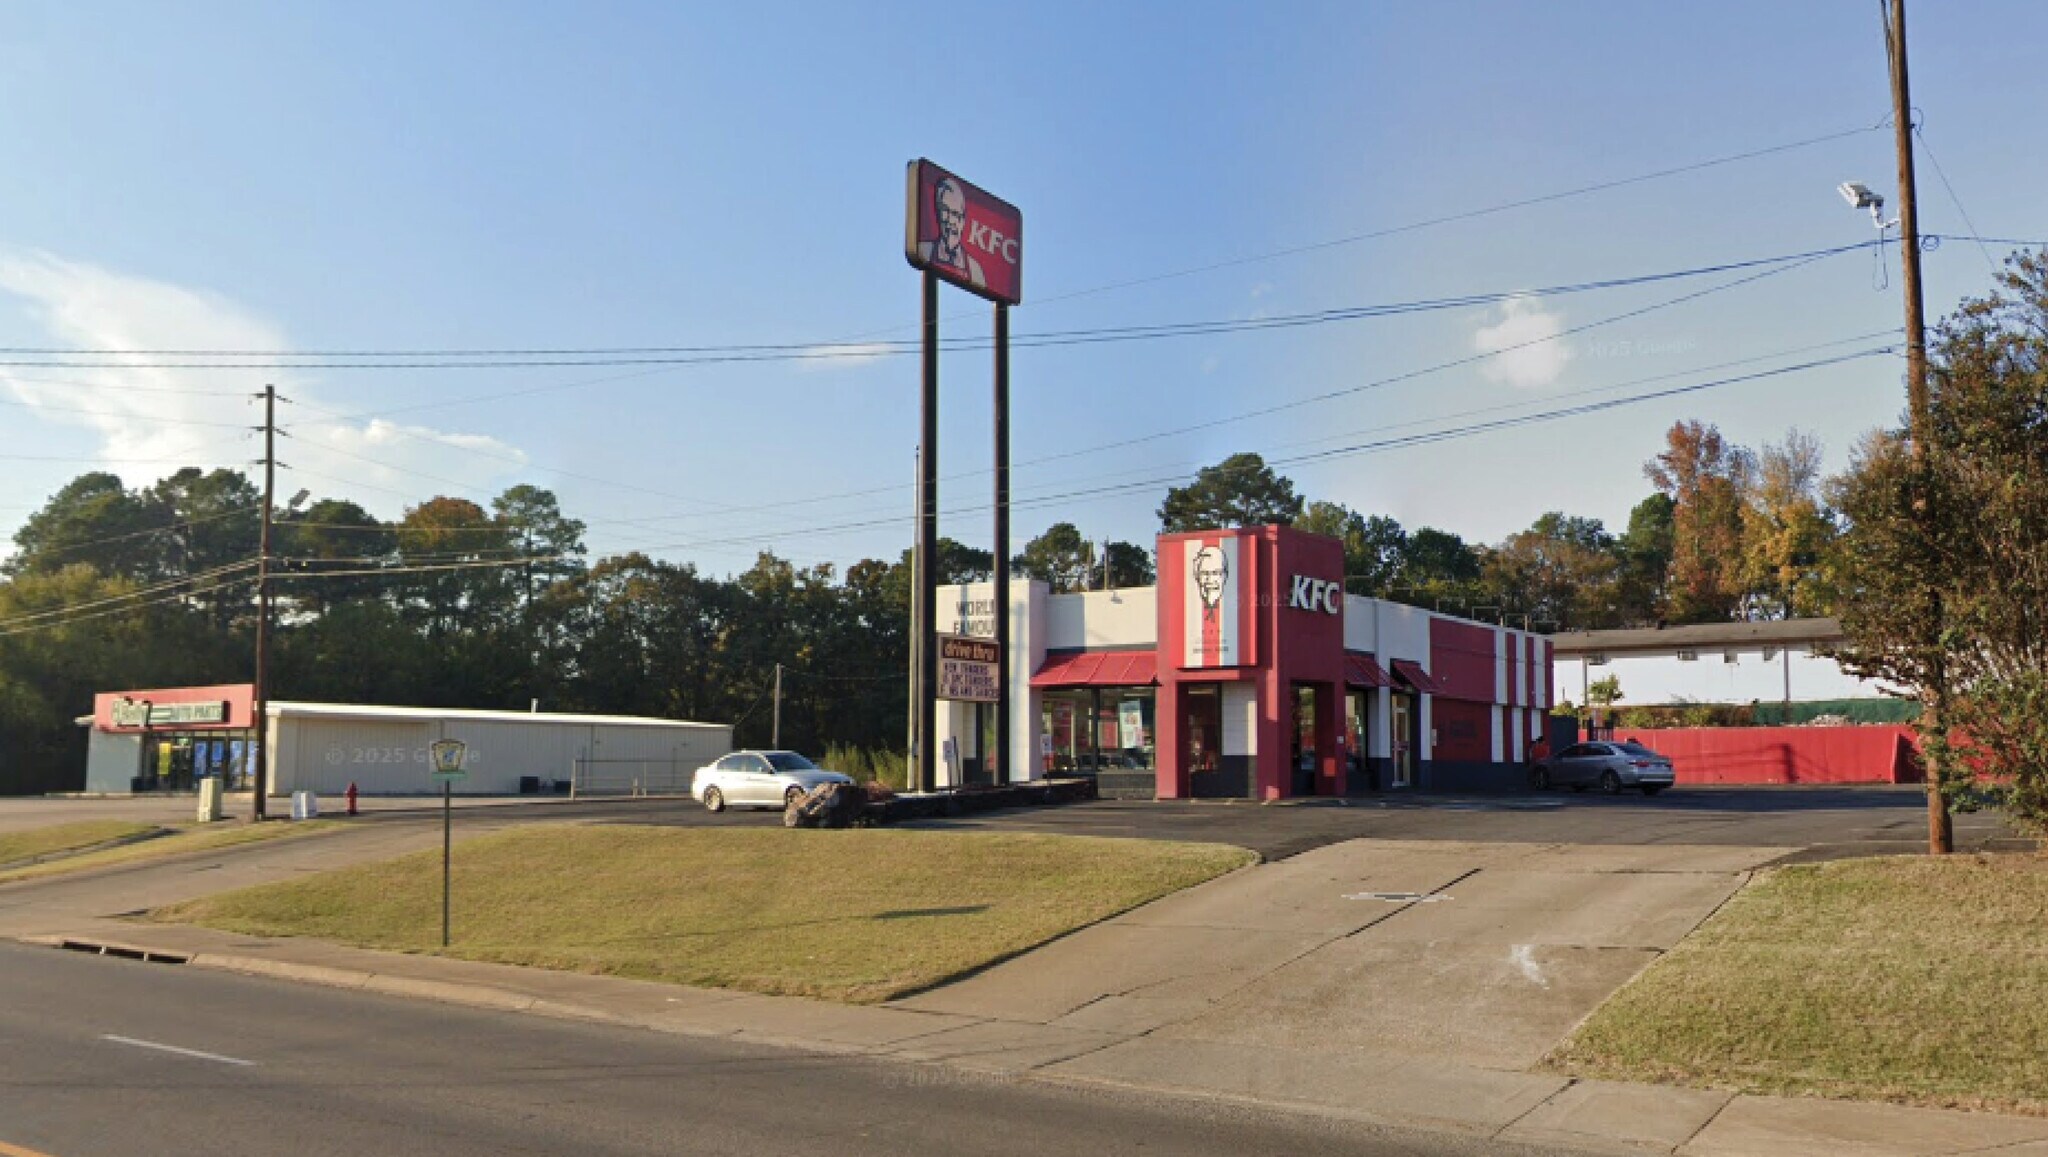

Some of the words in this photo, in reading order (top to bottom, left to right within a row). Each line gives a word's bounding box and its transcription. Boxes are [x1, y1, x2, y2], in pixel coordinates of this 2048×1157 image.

[966, 219, 1019, 265] KFC
[1289, 574, 1340, 615] KFC
[953, 619, 997, 636] FAMOU
